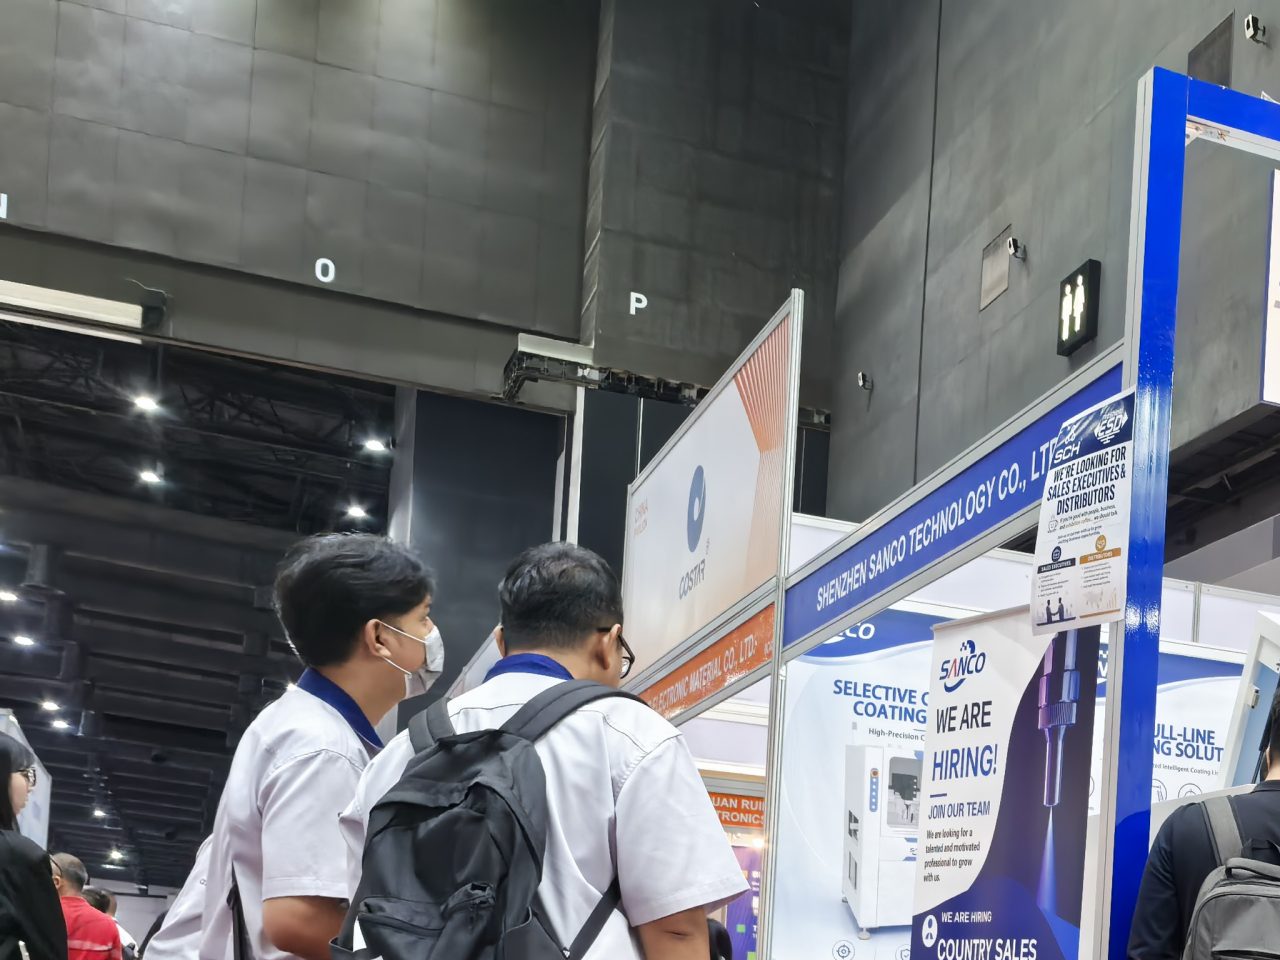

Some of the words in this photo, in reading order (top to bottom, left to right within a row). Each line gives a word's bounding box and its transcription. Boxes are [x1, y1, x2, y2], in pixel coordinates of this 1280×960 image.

[629, 291, 648, 315] P
[1053, 461, 1075, 483] WE'RE
[1076, 451, 1109, 475] LOOKING
[1110, 445, 1126, 464] FOR
[1047, 480, 1070, 501] SALES
[1071, 463, 1119, 493] EXECUTIVES
[1120, 463, 1126, 479] &
[1056, 484, 1115, 516] DISTRIBUTORS
[816, 559, 867, 611] SHENZHEN
[868, 534, 907, 579] SANCO
[909, 475, 996, 556] TECHNOLOGY
[998, 462, 1026, 501] CO.,
[939, 652, 986, 680] SANCO
[833, 680, 917, 704] SELECTIVE
[853, 701, 927, 724] COATING
[936, 705, 957, 734] WE
[959, 700, 992, 730] ARE
[932, 743, 998, 781] HIRING!
[928, 804, 946, 819] JOIN
[947, 802, 964, 818] OUR
[966, 801, 990, 816] TEAM
[926, 830, 933, 839] We
[942, 830, 959, 839] looking
[960, 828, 968, 837] for
[926, 844, 943, 853] talented
[944, 843, 953, 852] and
[954, 842, 980, 852] motivated
[924, 858, 951, 869] professional
[952, 858, 957, 866] to
[959, 859, 972, 868] grow
[941, 912, 953, 923] WE
[953, 912, 970, 923] ARE
[970, 911, 992, 923] HIRING
